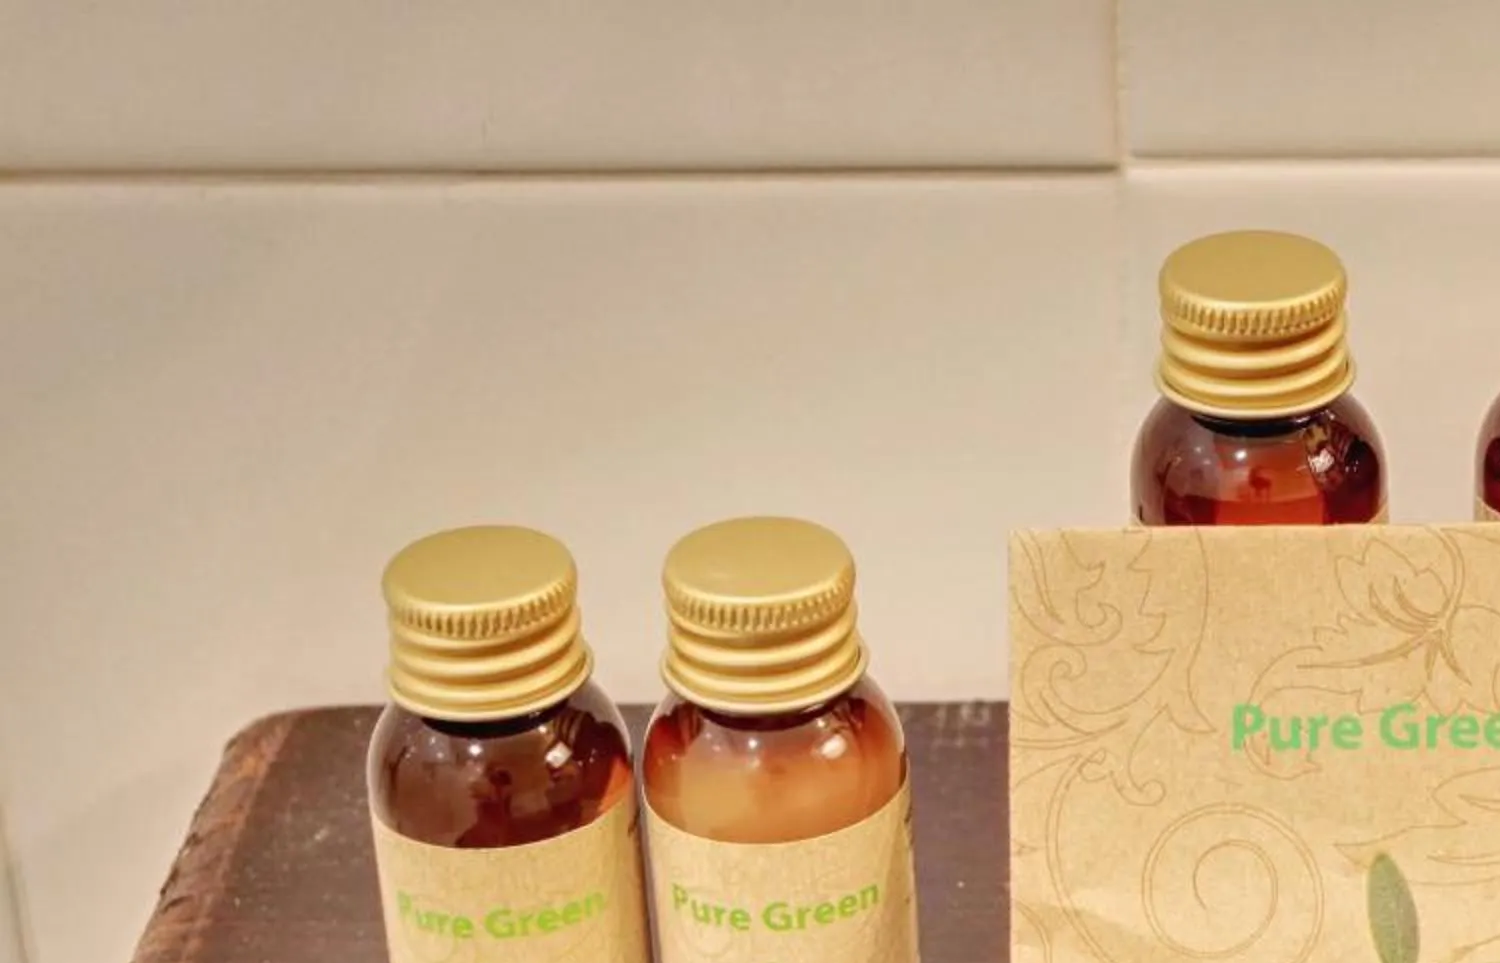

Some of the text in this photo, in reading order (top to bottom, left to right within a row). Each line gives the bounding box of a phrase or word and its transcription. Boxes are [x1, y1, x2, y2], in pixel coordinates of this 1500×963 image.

[1232, 703, 1363, 750] Pure
[397, 889, 604, 938] Pure Green
[672, 882, 879, 932] Pure Green
